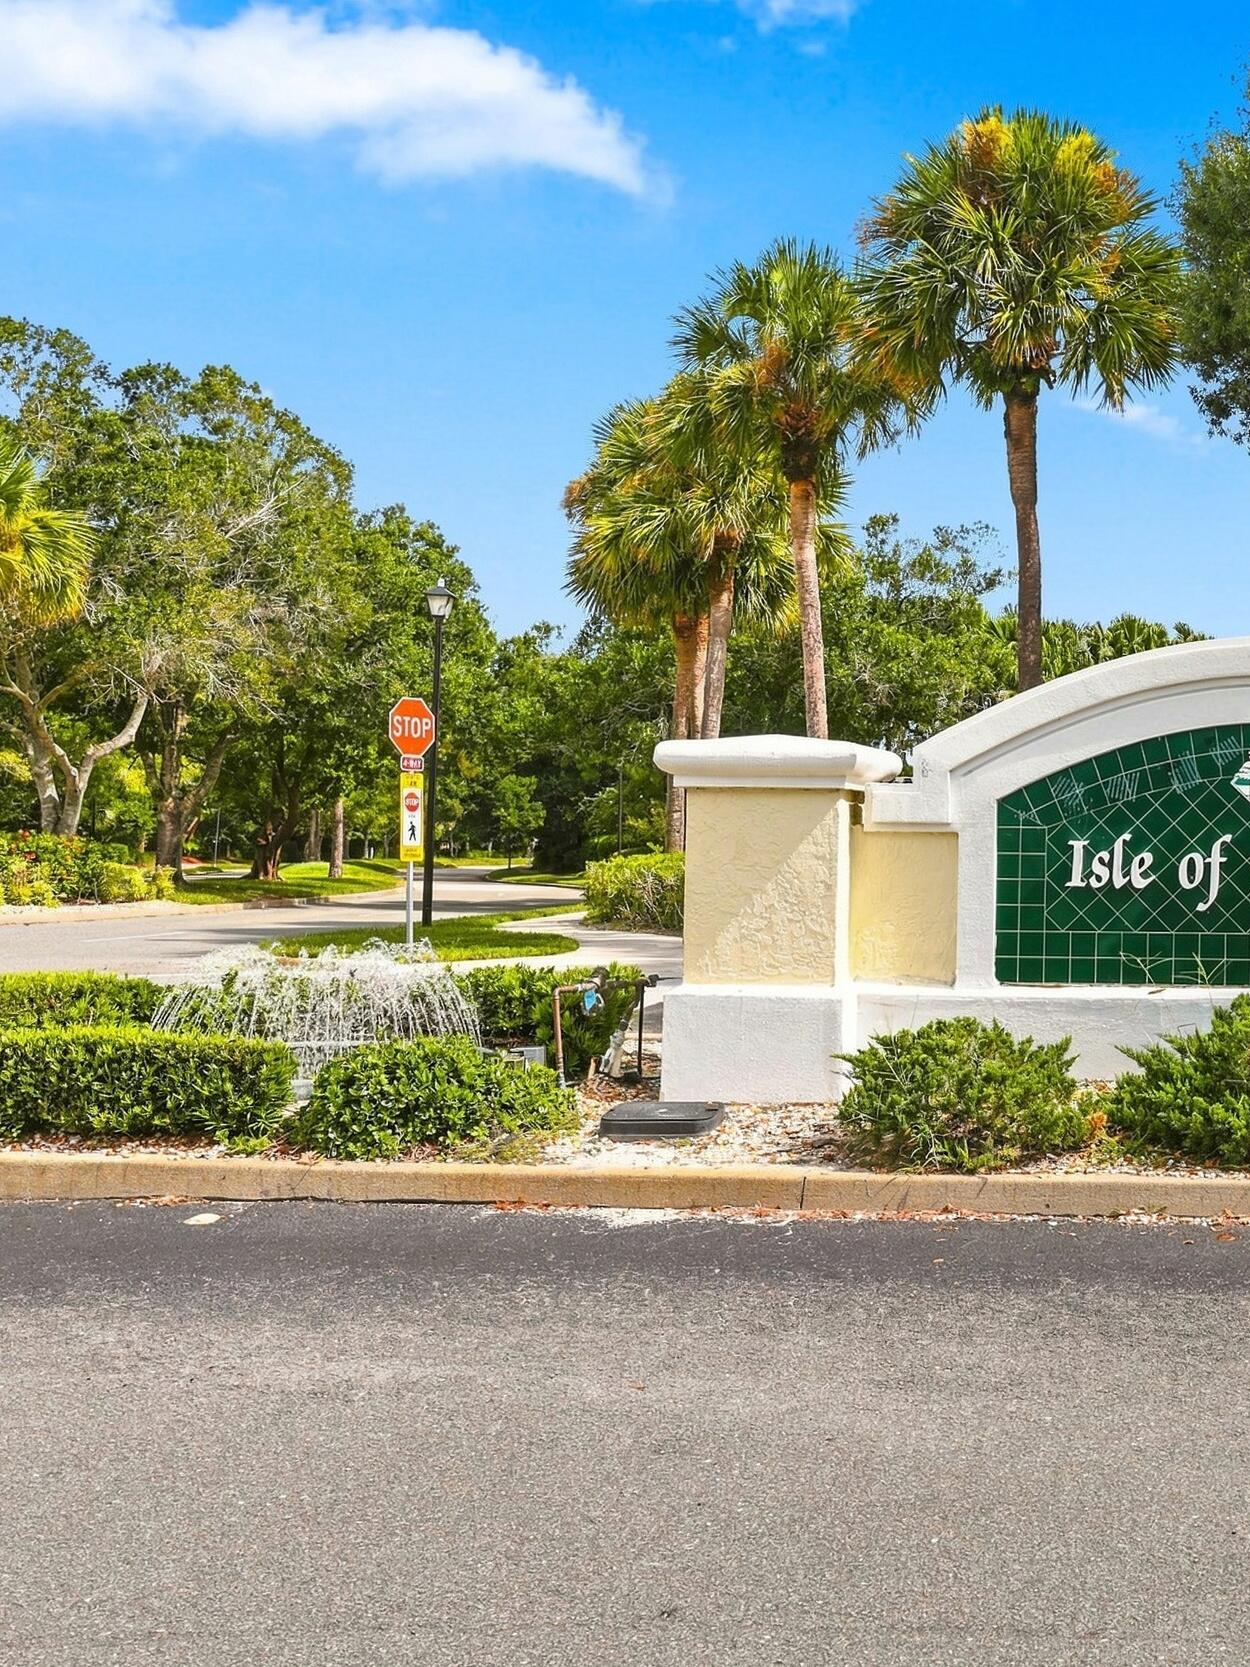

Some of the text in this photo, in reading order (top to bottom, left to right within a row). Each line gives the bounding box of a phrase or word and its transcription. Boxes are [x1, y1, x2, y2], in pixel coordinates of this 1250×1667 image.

[393, 716, 432, 738] STOP
[1065, 833, 1156, 890] Isle
[1178, 833, 1233, 912] of
